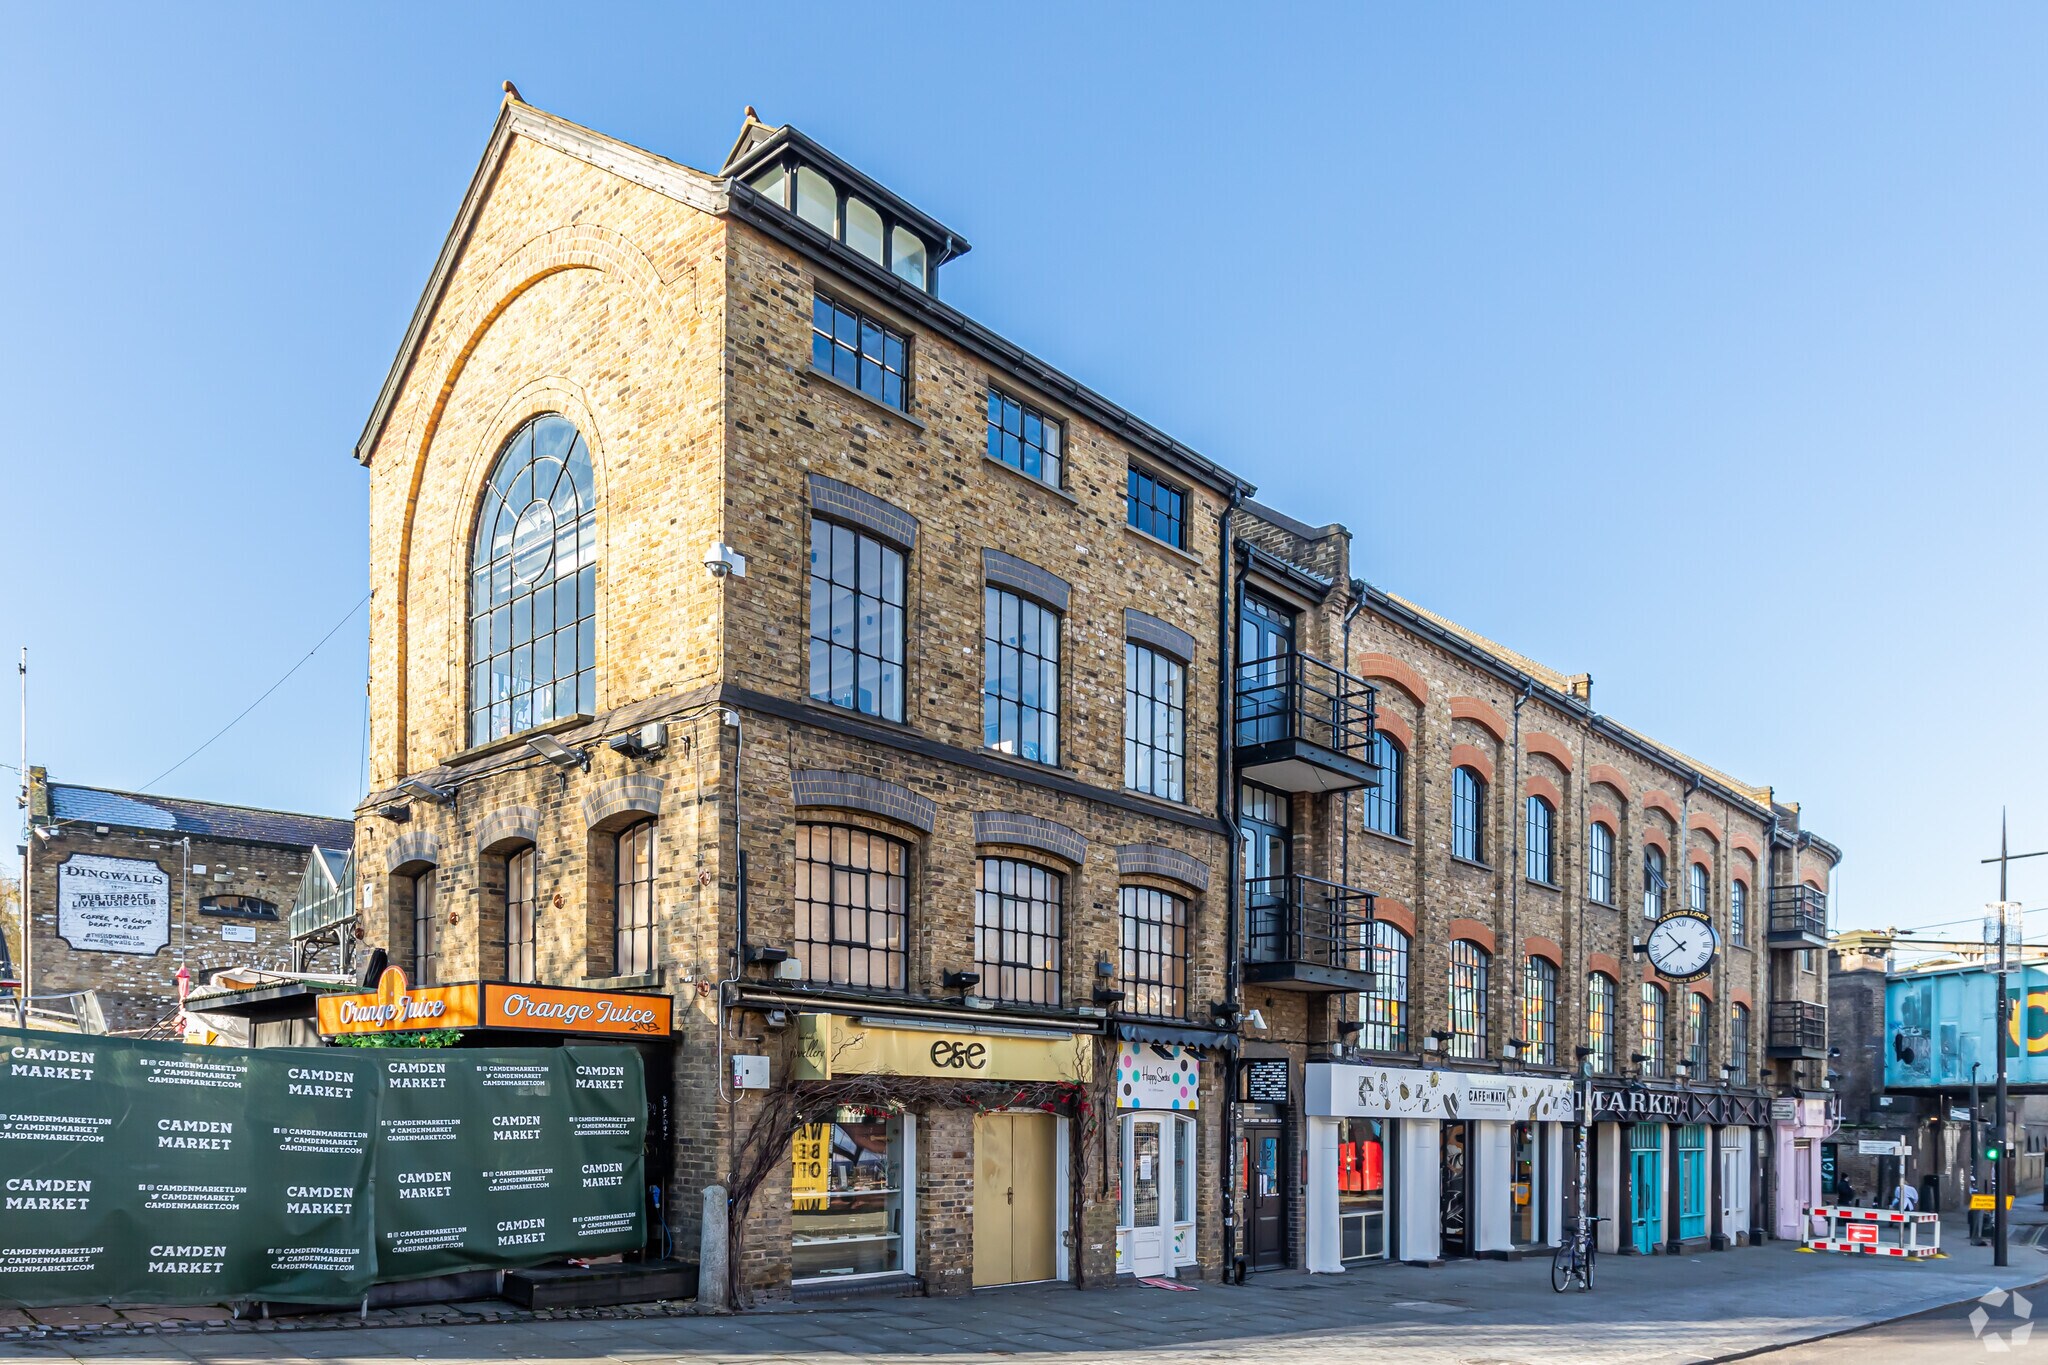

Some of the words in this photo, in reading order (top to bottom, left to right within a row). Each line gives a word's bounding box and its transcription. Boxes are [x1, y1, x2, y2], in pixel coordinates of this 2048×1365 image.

[65, 866, 163, 885] DINGWALLS
[1658, 911, 1688, 923] CAMDEN
[1689, 910, 1709, 920] LOCK
[1689, 971, 1709, 981] HALL
[340, 1000, 397, 1027] Orange
[397, 996, 446, 1022] Juice
[503, 994, 592, 1024] Orange
[596, 1000, 656, 1024] Juice
[11, 1046, 95, 1064] CAMDEN
[158, 1060, 248, 1072] CAMDENMARKETLDN
[388, 1062, 446, 1073] CAMDEN
[576, 1066, 624, 1076] CAMDEN
[11, 1064, 94, 1081] MARKET
[164, 1068, 237, 1080] CAMDENMARKET
[288, 1068, 354, 1083] CAMDEN
[1142, 1065, 1157, 1085] Happy
[1157, 1066, 1171, 1082] Socks
[147, 1076, 242, 1088] CAMDENMARKET.COM
[389, 1078, 446, 1088] MARKET
[575, 1079, 624, 1089] MARKET
[288, 1084, 354, 1098] MARKET
[1468, 1090, 1486, 1102] CAFE
[1491, 1092, 1506, 1103] NATA
[1575, 1091, 1680, 1115] MARKET
[9, 1114, 112, 1125] CAMDENMARKETLDN
[492, 1115, 541, 1126] CAMDEN
[15, 1123, 99, 1133] CAMDENMARKET
[158, 1119, 233, 1134] CAMDEN
[289, 1128, 368, 1138] CAMDENMARKETLDN
[493, 1129, 541, 1141] MARKET
[158, 1136, 232, 1150] MARKET
[293, 1137, 358, 1146] CAMDENMARKET
[279, 1144, 362, 1154] CAMDENMARKET.COM
[495, 1168, 554, 1177] CAMDENMARKETLDN
[581, 1163, 623, 1174] CAMDEN
[398, 1171, 452, 1184] CAMDEN
[499, 1176, 546, 1184] CAMDENMARKET
[582, 1176, 623, 1188] MARKET
[6, 1179, 91, 1192] CAMDEN
[156, 1184, 247, 1193] CAMDENMARKETLDN
[161, 1193, 235, 1202] CAMDENMARKET
[286, 1186, 354, 1198] CAMDEN
[399, 1187, 452, 1199] MARKET
[6, 1197, 90, 1210] MARKET
[145, 1202, 240, 1210] CAMDENMARKET.COM
[286, 1202, 352, 1214] MARKET
[583, 1212, 636, 1222] CAMDENMARKETLDN
[497, 1218, 545, 1231] CAMDEN
[587, 1220, 630, 1229] CAMDENMARKET
[400, 1227, 467, 1237] CAMDENMARKETLDN
[404, 1235, 460, 1245] CAMDENMARKET
[498, 1232, 546, 1246] MARKET
[2, 1246, 104, 1256] CAMDENMARKETLDN
[150, 1246, 226, 1257] CAMDEN
[283, 1247, 360, 1255] CAMDENMARKETLDN
[7, 1256, 90, 1264] CAMDENMARKET
[0, 1264, 95, 1273] AMDENMARKET.COM
[148, 1262, 224, 1274] MARKET
